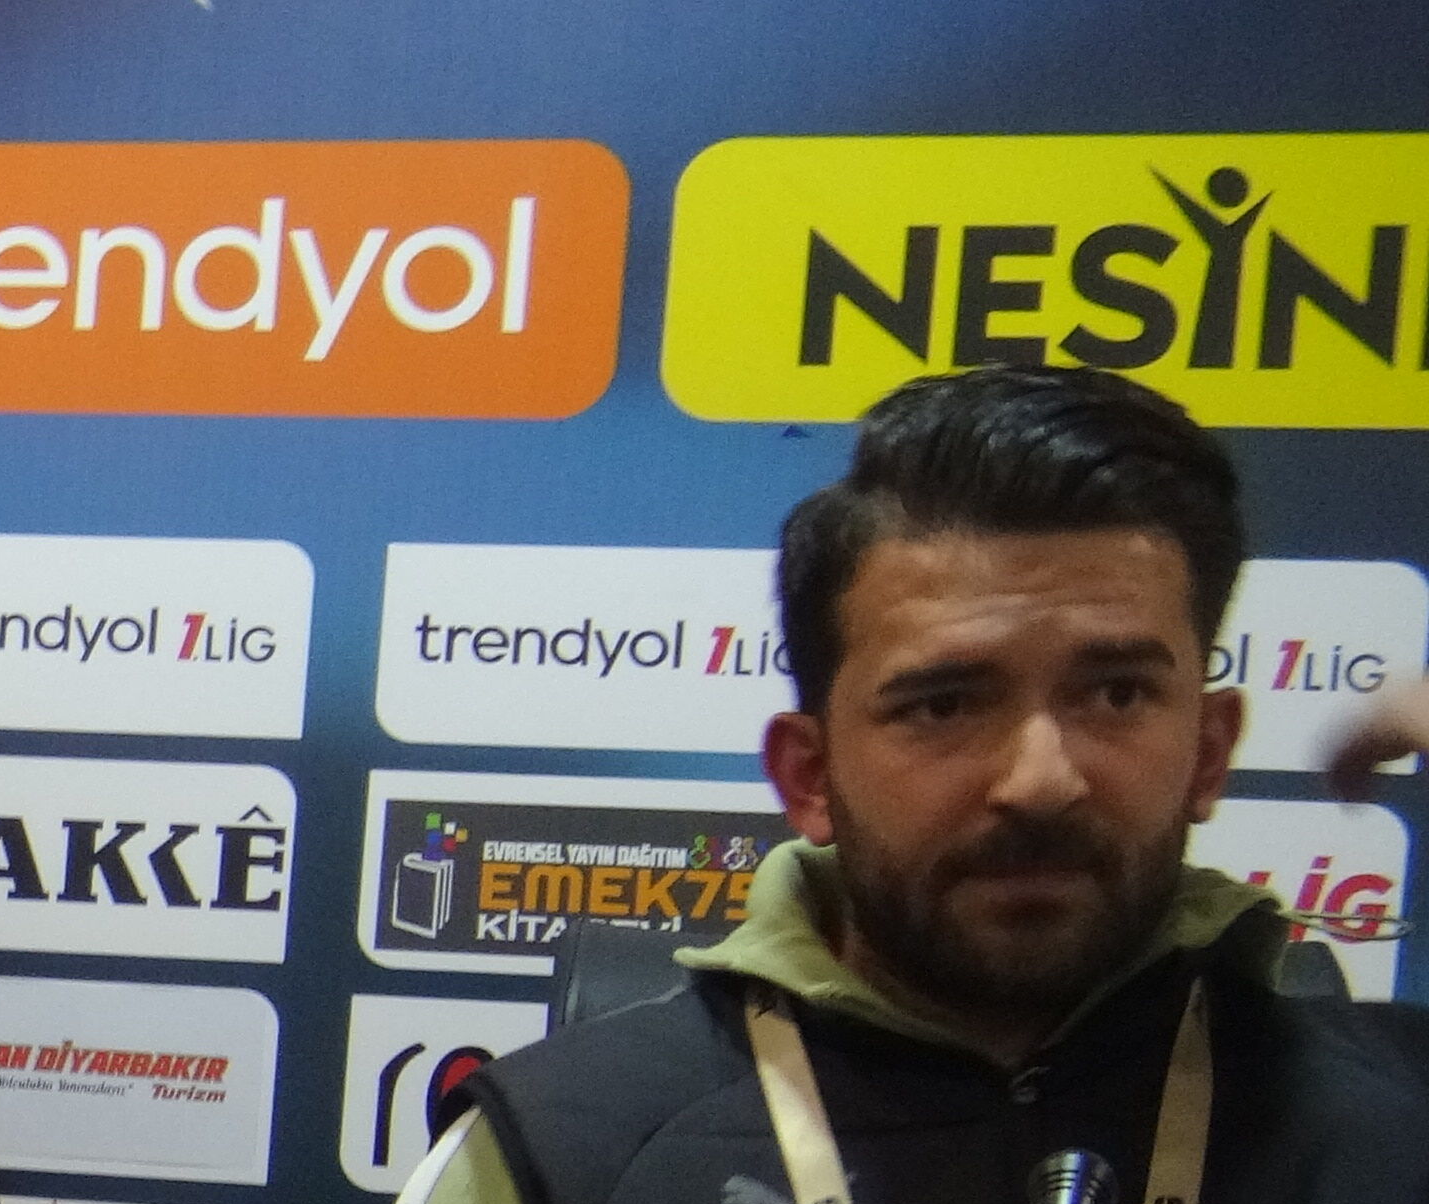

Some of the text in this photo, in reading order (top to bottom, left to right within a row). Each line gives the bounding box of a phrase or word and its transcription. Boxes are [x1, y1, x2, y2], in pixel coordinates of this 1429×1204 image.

[798, 163, 1429, 371] NESIN
[414, 613, 687, 680] trendyol
[481, 839, 690, 869] EVRENSEL YAYIN DAĞITIM
[34, 1039, 229, 1083] DİYARBAKIR
[152, 1082, 227, 1104] Turizm
